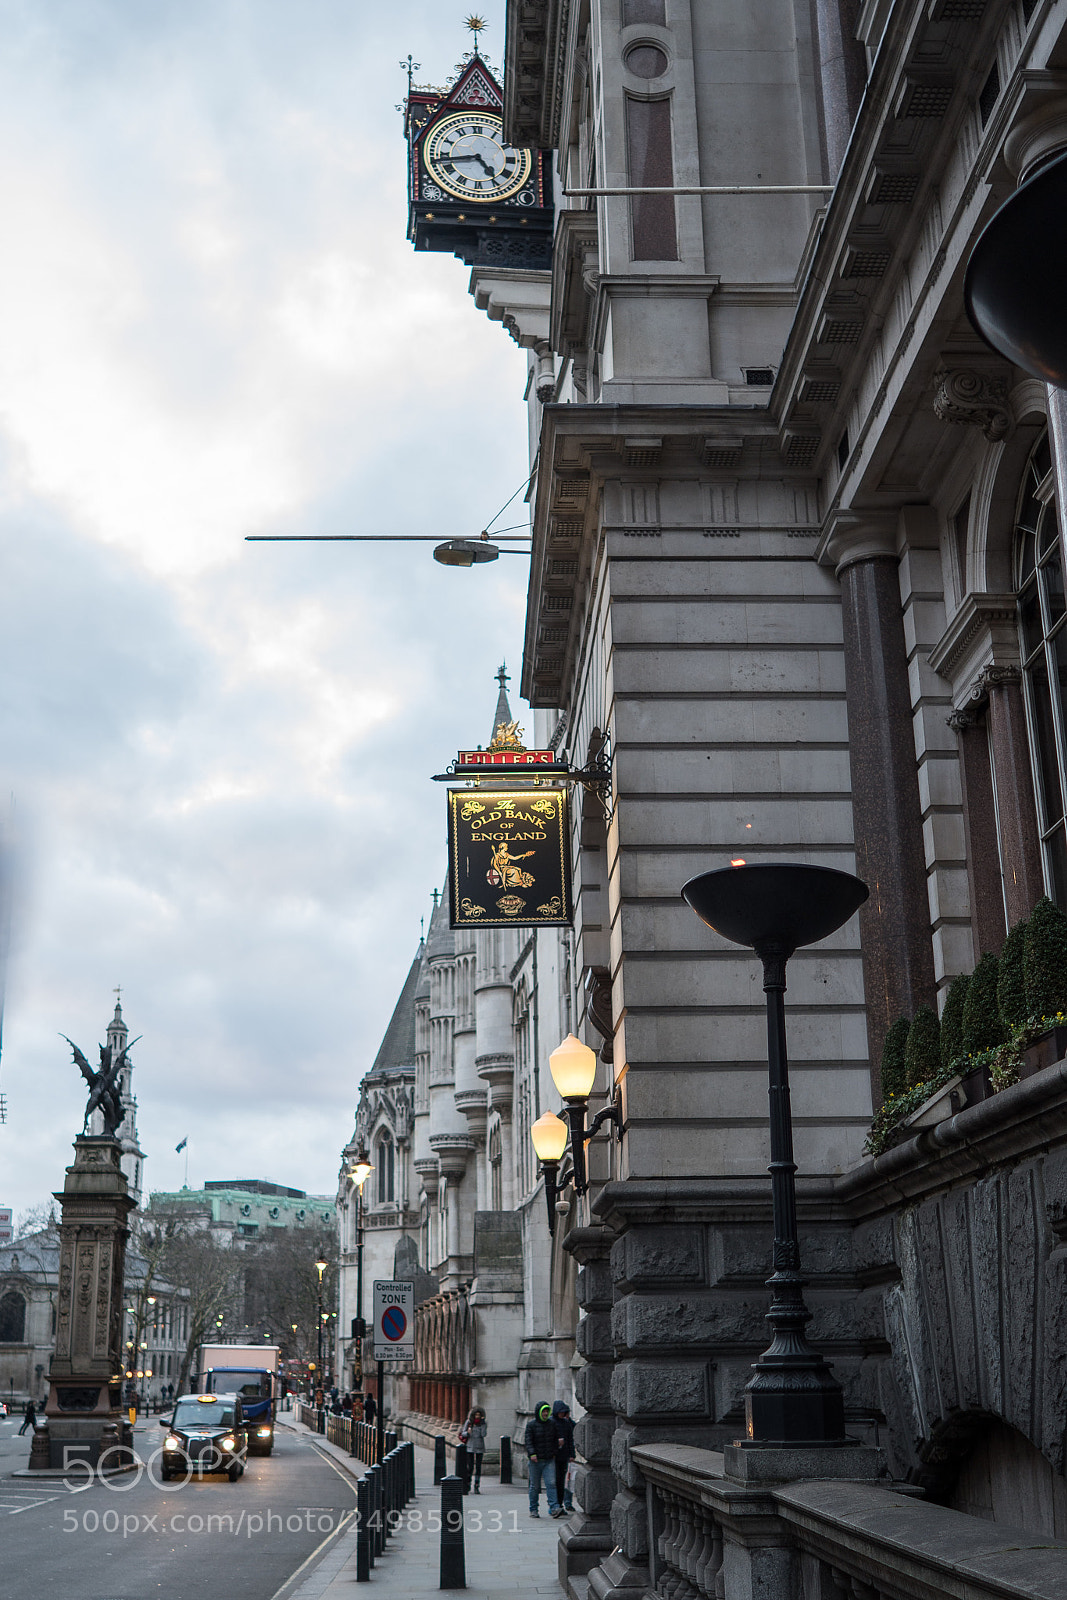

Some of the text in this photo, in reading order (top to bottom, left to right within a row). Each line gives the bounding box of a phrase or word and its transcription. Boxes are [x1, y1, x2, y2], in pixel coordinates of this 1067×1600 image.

[493, 799, 516, 810] The
[471, 809, 547, 830] OLD BANK
[471, 832, 547, 842] ENGLAND
[376, 1283, 412, 1292] Controlled
[381, 1294, 407, 1304] ZONE
